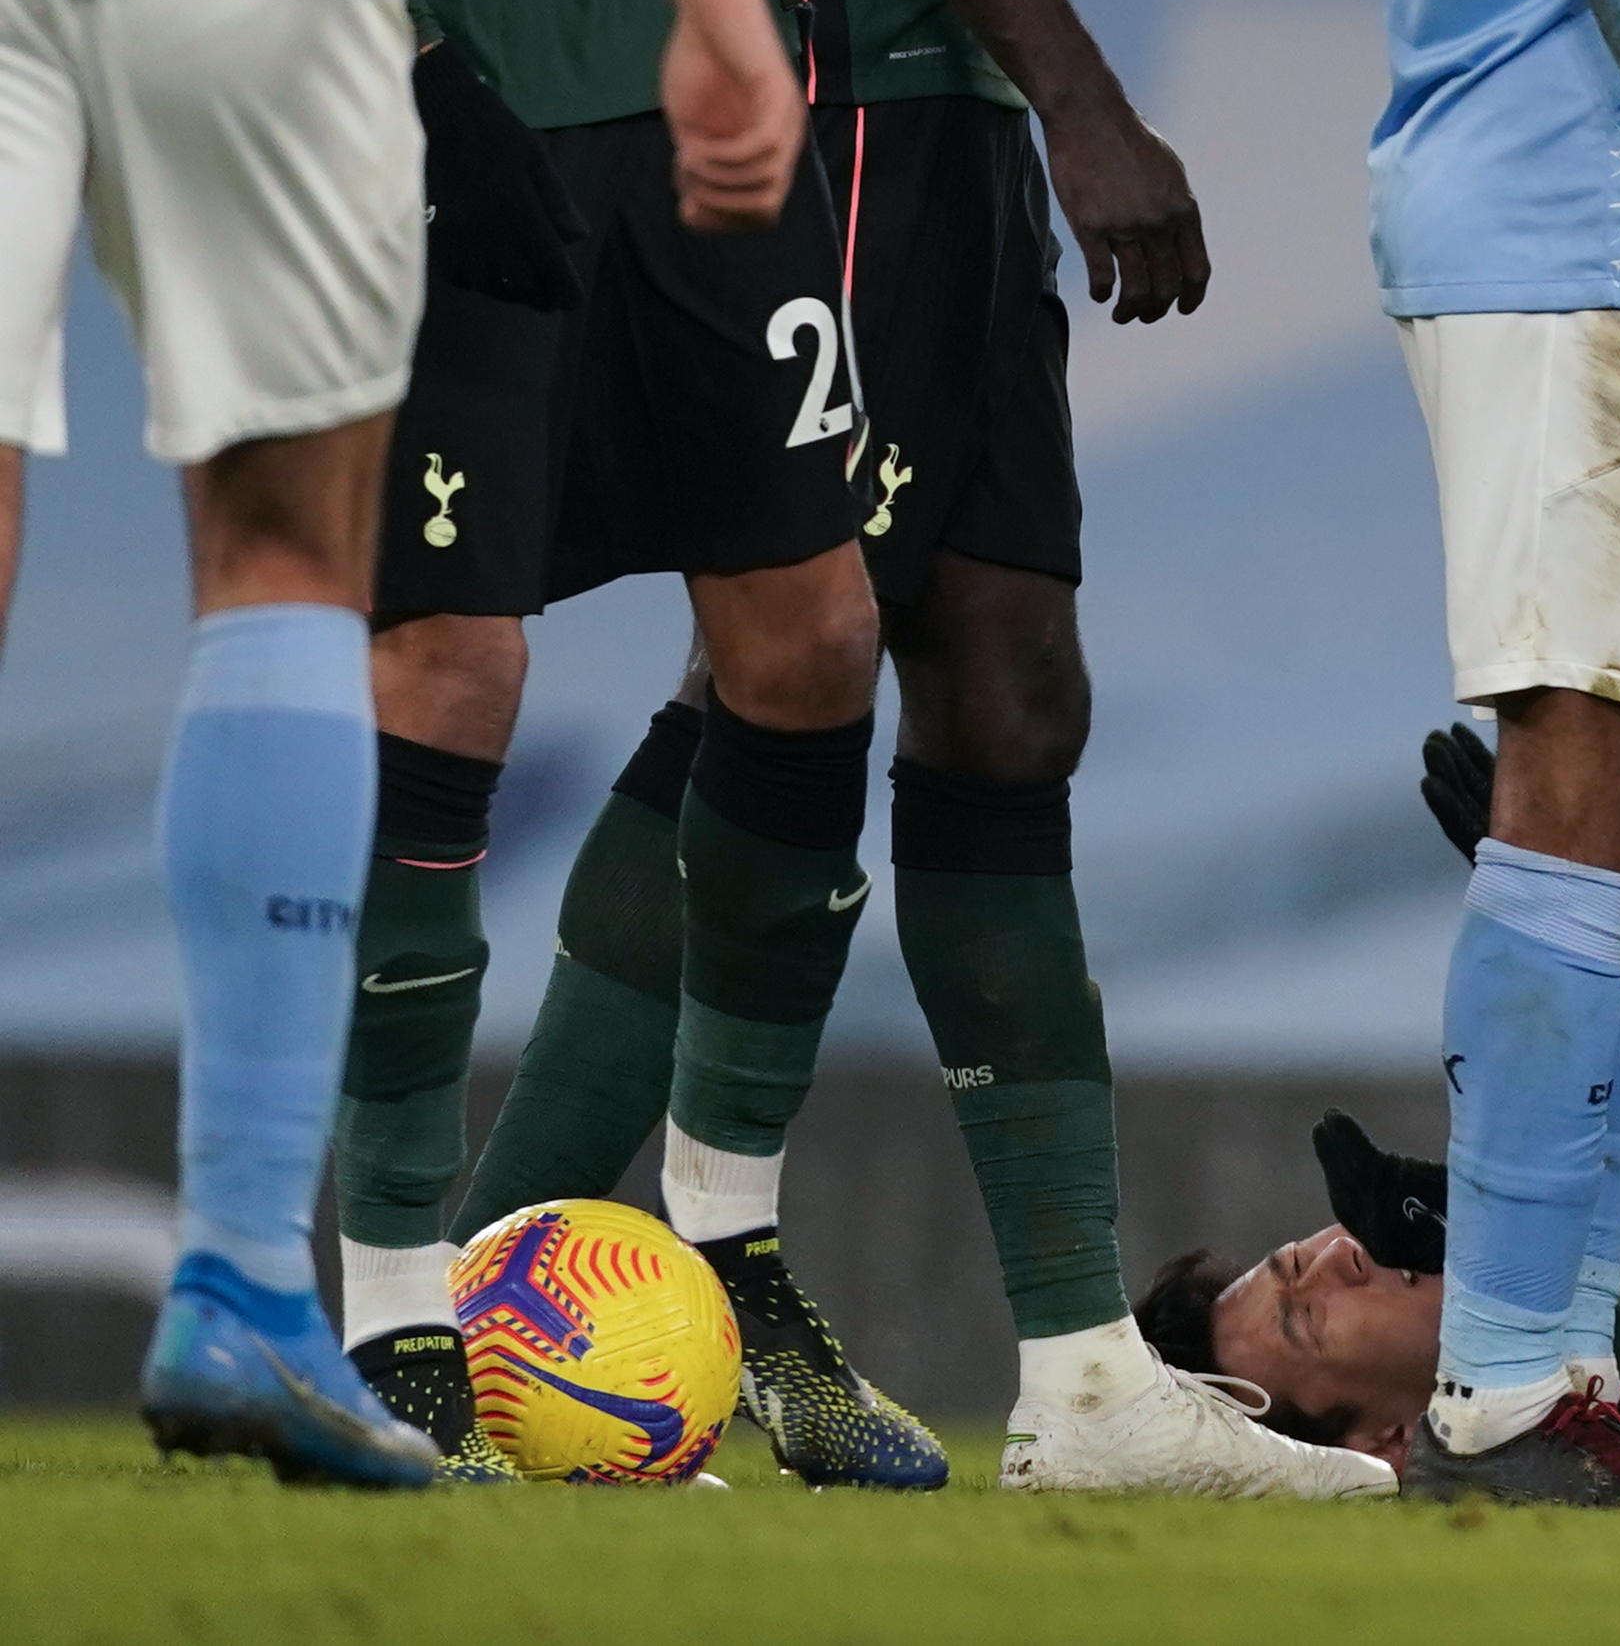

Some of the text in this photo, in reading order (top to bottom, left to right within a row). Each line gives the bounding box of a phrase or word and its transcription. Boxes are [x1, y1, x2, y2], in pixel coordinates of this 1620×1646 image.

[766, 294, 863, 449] 2
[940, 1065, 995, 1090] PURS
[393, 1335, 456, 1355] PREDATOR
